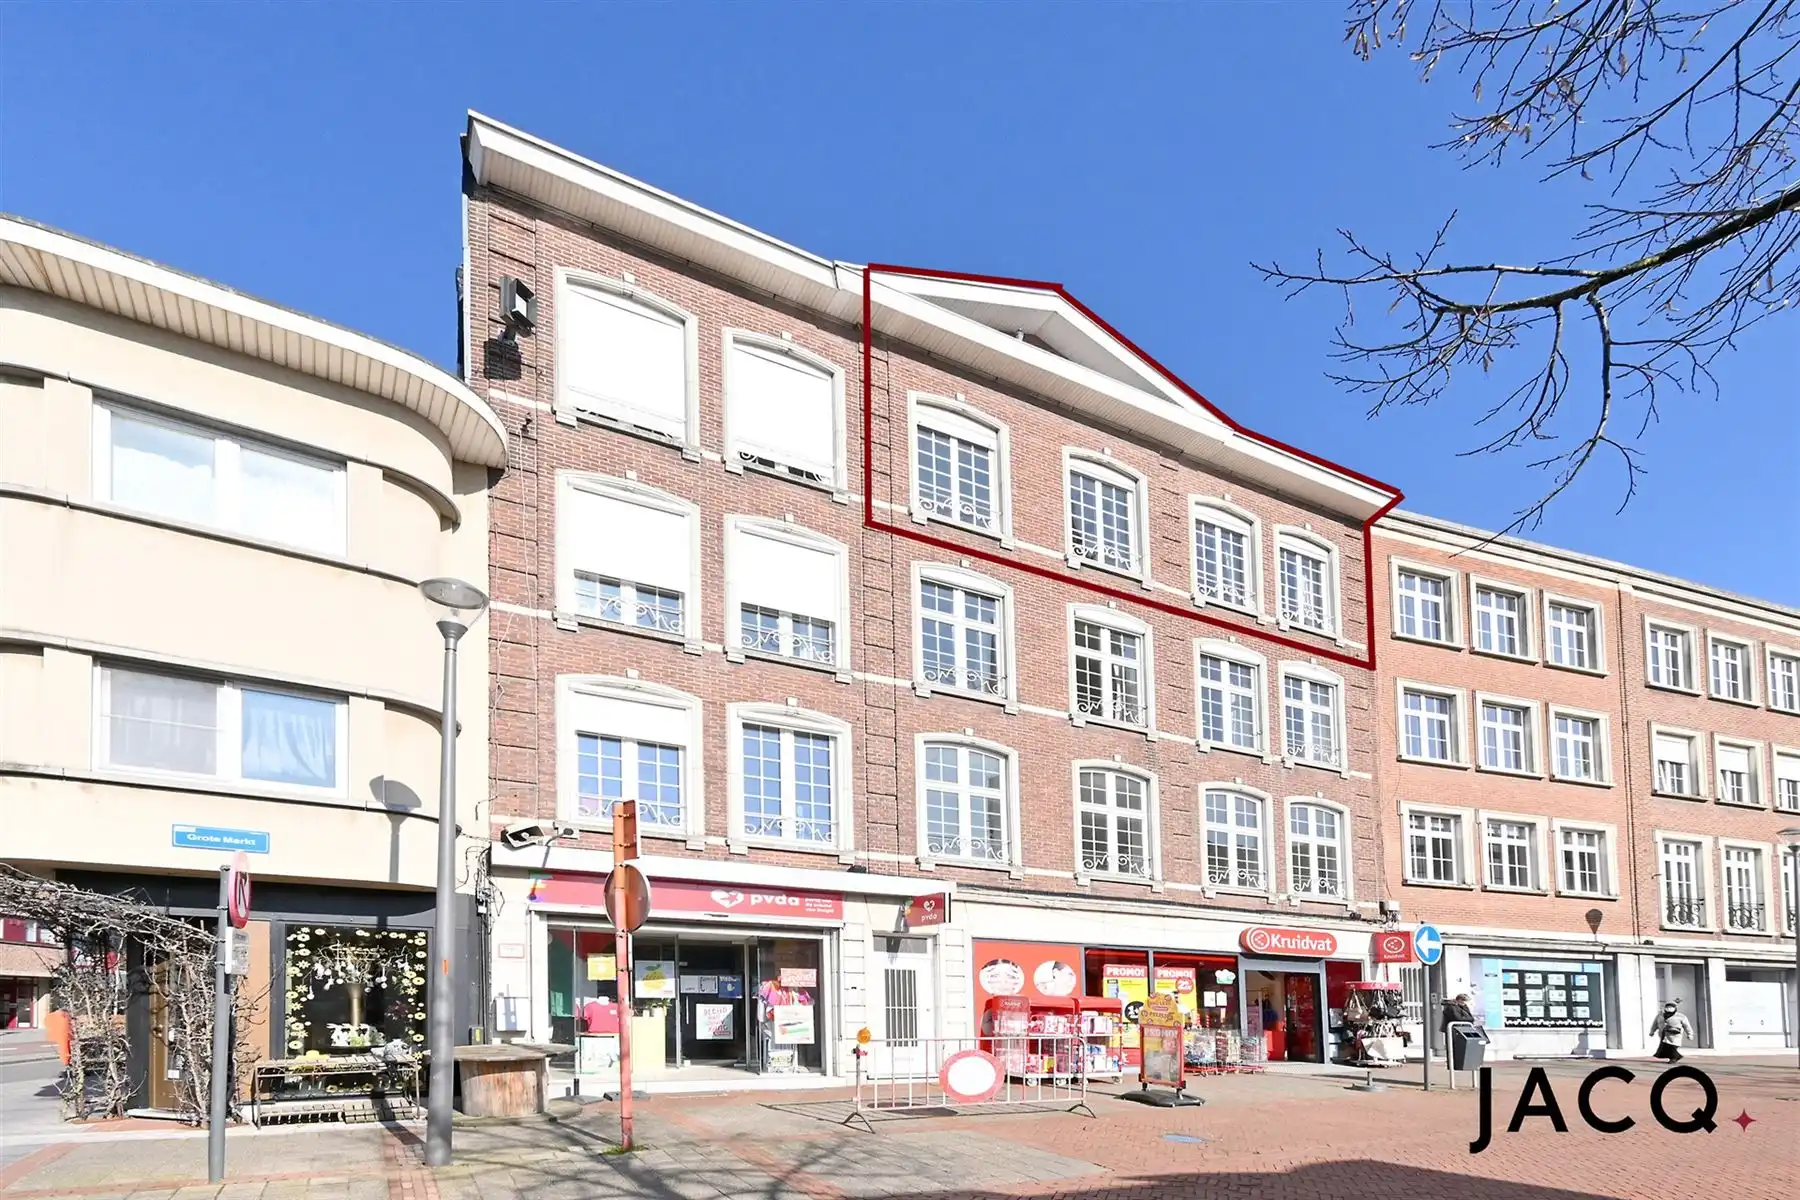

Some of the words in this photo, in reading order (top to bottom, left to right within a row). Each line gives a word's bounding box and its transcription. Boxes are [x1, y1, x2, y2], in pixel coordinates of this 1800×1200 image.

[187, 833, 220, 843] Grote
[223, 836, 256, 846] Markt
[750, 893, 800, 907] pvda
[921, 914, 938, 923] pvda
[1271, 933, 1333, 951] Kruidvat
[1106, 966, 1145, 978] PROMO!
[1157, 968, 1193, 979] PROMO!
